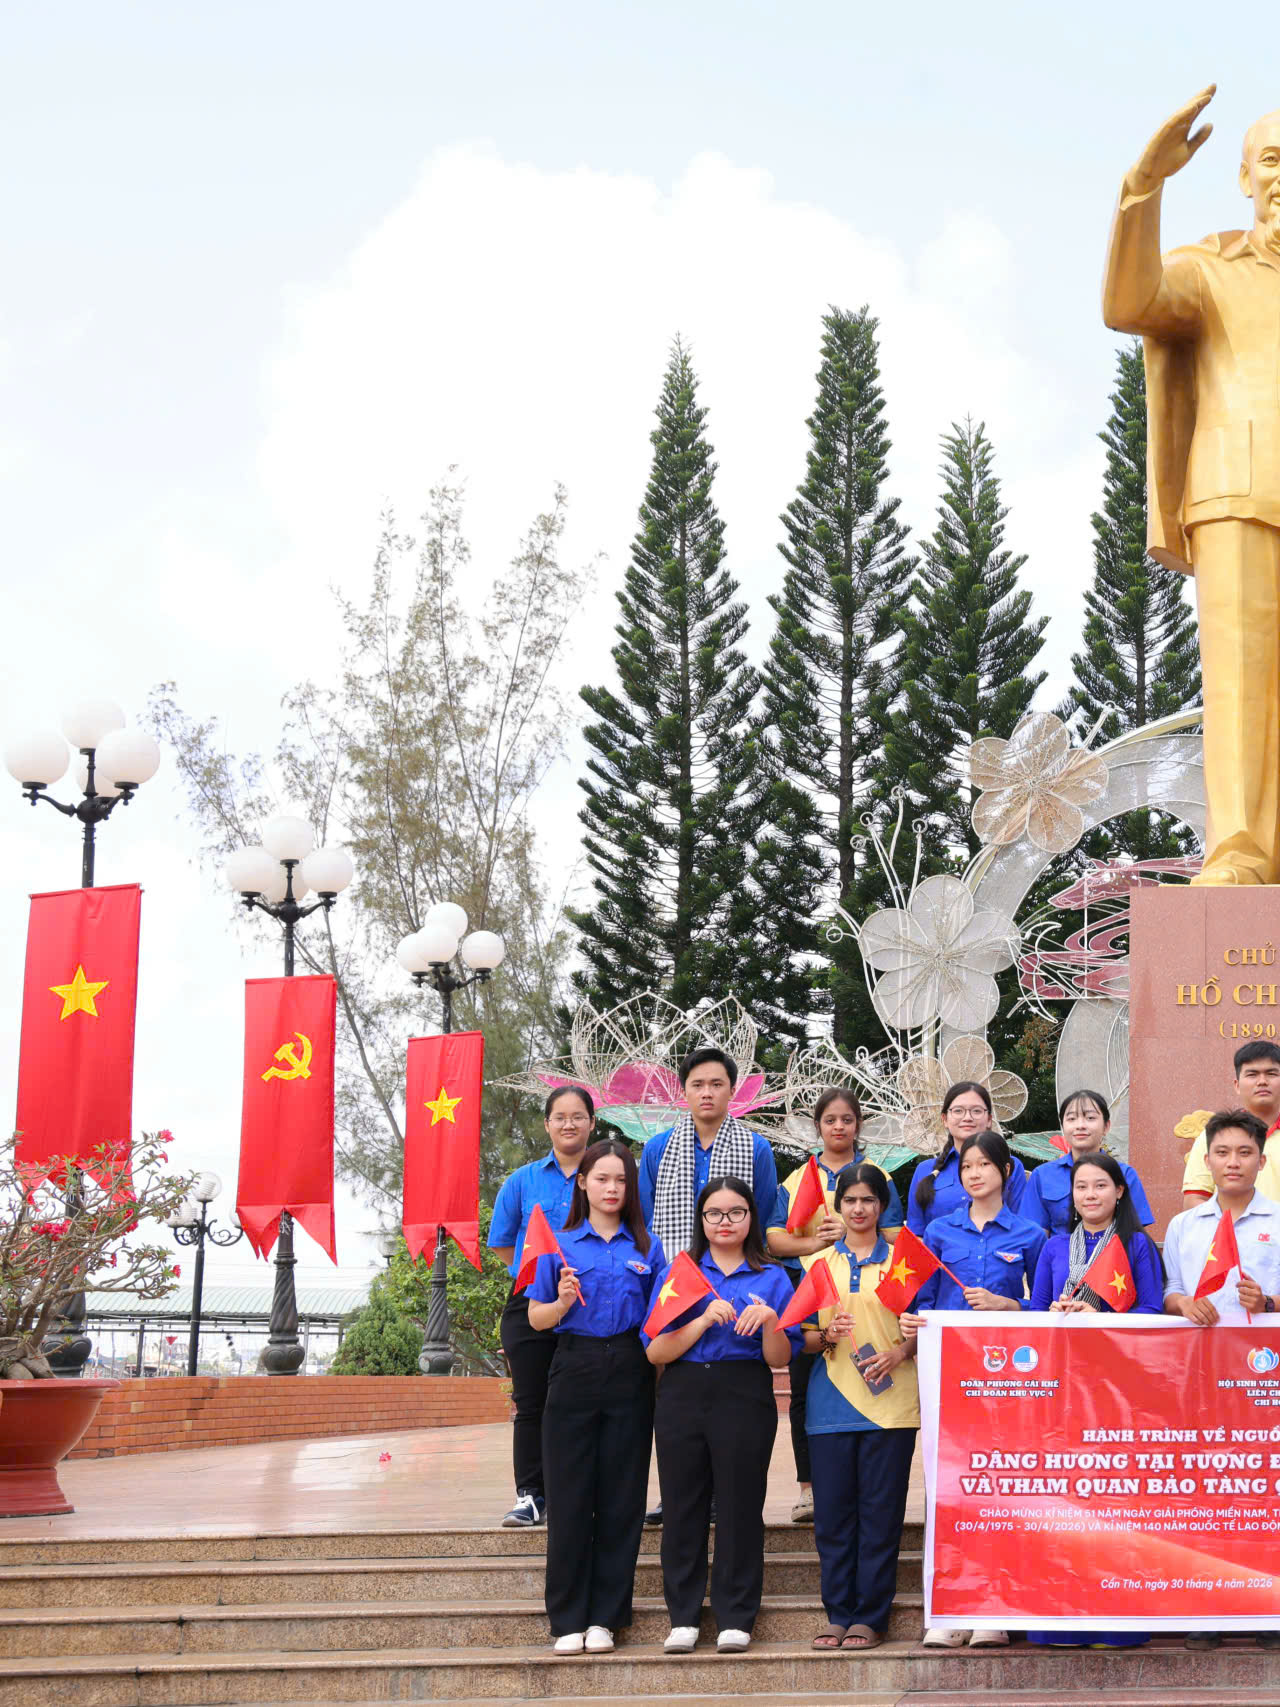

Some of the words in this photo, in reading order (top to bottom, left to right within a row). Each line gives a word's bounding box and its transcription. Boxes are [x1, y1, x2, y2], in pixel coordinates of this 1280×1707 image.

[1224, 941, 1275, 965] CHỦ
[1176, 975, 1222, 1006] HỒ
[1218, 1379, 1234, 1388] HỘI
[1259, 1379, 1279, 1387] VIÊN
[1247, 1388, 1267, 1397] LIÊN
[1083, 1428, 1134, 1442] HÀNH
[1140, 1427, 1197, 1442] TRÌNH
[1202, 1426, 1226, 1442] VỀ
[971, 1450, 1037, 1469] DÂNG
[1044, 1453, 1128, 1469] HƯƠNG
[1136, 1453, 1175, 1472] TẠI
[1182, 1453, 1263, 1472] TƯỢNG
[961, 1475, 992, 1493] VÀ
[998, 1478, 1068, 1494] THAM
[1075, 1478, 1140, 1496] QUAN
[1147, 1475, 1196, 1493] BẢO
[1204, 1475, 1267, 1493] TÀNG
[979, 1507, 1010, 1518] CHÀO
[1012, 1507, 1042, 1518] MỪNG
[1058, 1507, 1082, 1519] NIỆM
[1085, 1510, 1096, 1518] 51
[1098, 1507, 1121, 1518] NĂM
[1123, 1507, 1152, 1518] NGÀY
[1153, 1507, 1175, 1518] GIẢI
[1177, 1507, 1213, 1518] PHÓNG
[1243, 1509, 1270, 1518] NAM,
[954, 1521, 1013, 1532] (30/4/1975
[1024, 1521, 1086, 1532] 30/4/2026)
[1088, 1519, 1101, 1530] VÀ
[1116, 1520, 1141, 1532] NIỆM
[1144, 1522, 1161, 1530] 140
[1164, 1520, 1187, 1530] NĂM
[1189, 1519, 1221, 1531] QUỐC
[1222, 1519, 1237, 1530] TẾ
[1238, 1521, 1259, 1530] LAO
[1101, 1577, 1120, 1589] Cần
[1123, 1579, 1143, 1590] Thơ,
[1145, 1578, 1168, 1591] ngày
[1171, 1579, 1184, 1588] 30
[1186, 1578, 1213, 1590] tháng
[1215, 1579, 1222, 1588] 4
[1224, 1578, 1245, 1588] năm
[1247, 1578, 1273, 1588] 2026
